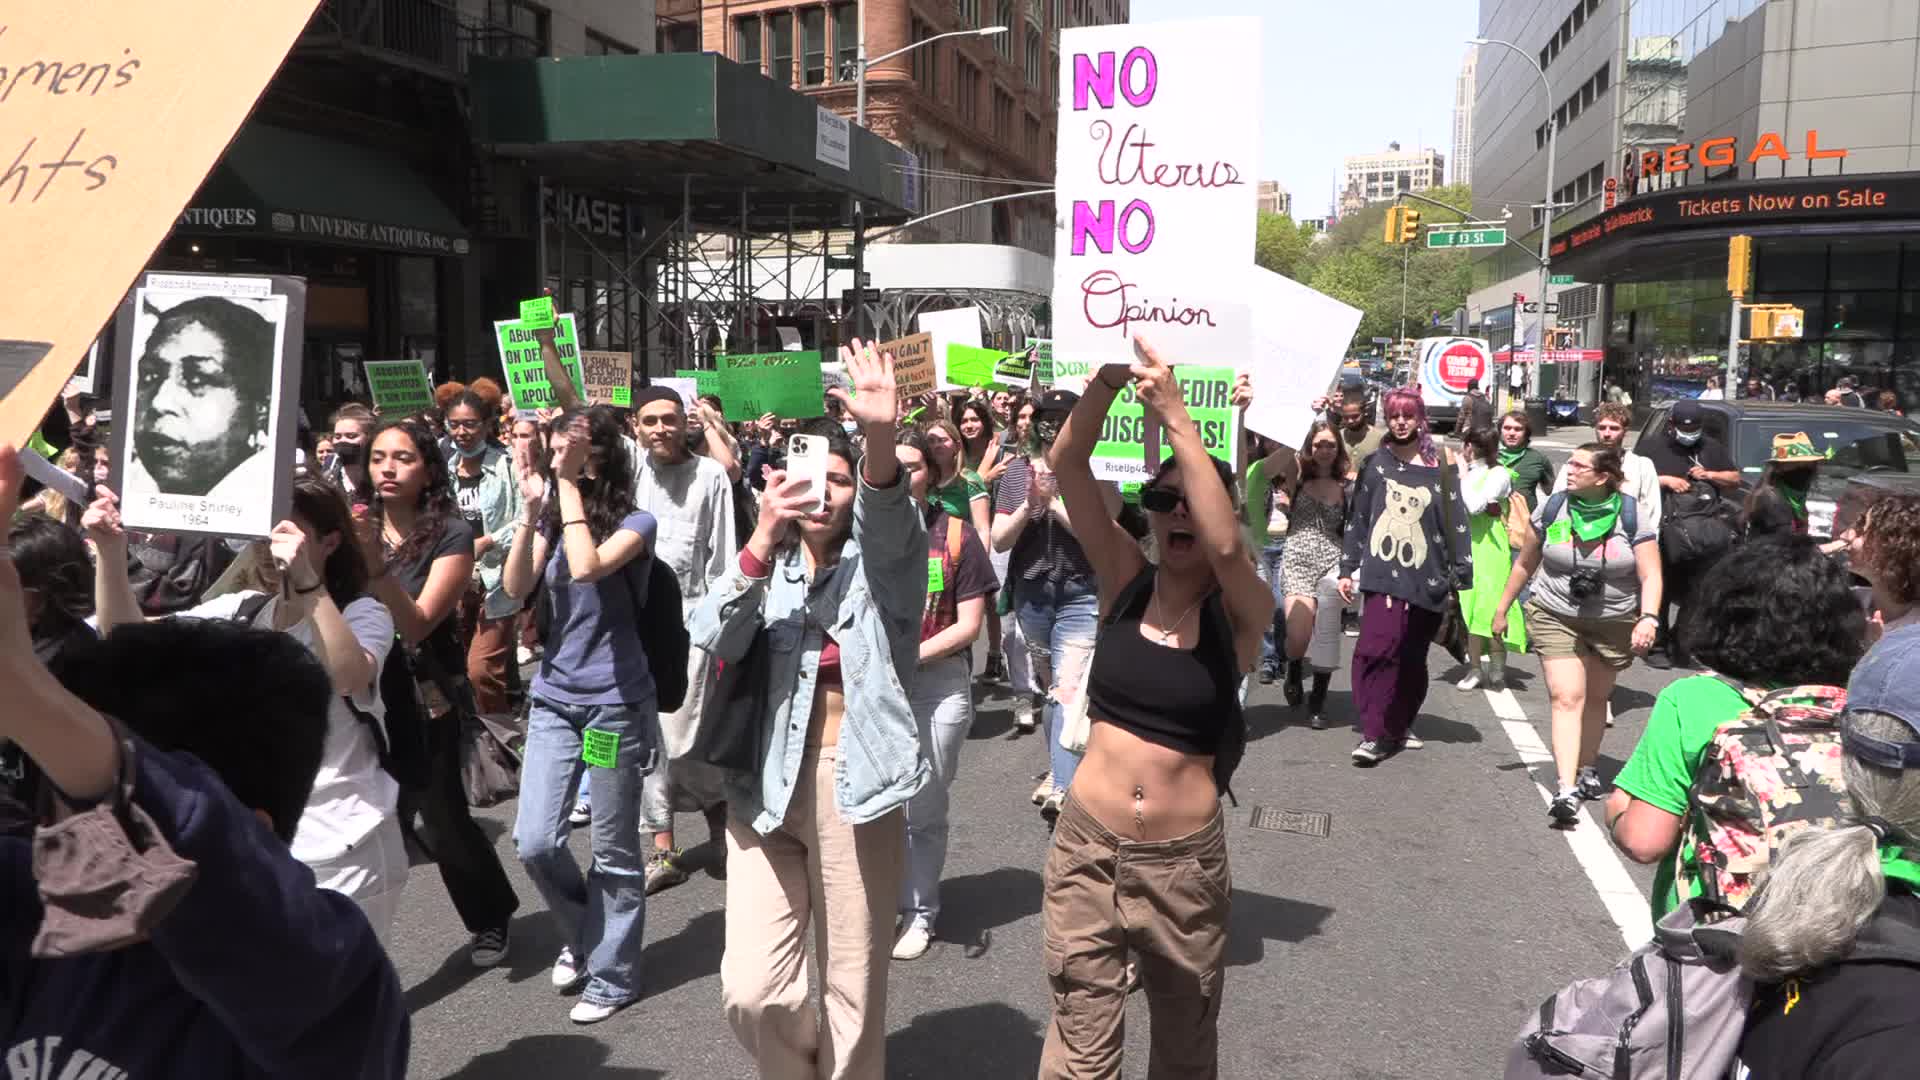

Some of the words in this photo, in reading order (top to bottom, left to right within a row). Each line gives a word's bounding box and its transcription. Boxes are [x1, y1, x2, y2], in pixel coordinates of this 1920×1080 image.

[1073, 46, 1158, 111] NO
[1089, 119, 1245, 188] Uterus
[1639, 130, 1848, 178] REGAL
[1071, 198, 1155, 256] NO
[1679, 199, 1741, 217] Tickets
[1748, 194, 1795, 211] Now
[1801, 194, 1829, 209] on
[1836, 189, 1887, 207] Sale
[300, 213, 369, 240] UNIVERSE
[370, 224, 432, 248] ANTIQUES
[1459, 233, 1470, 243] 13
[1081, 270, 1217, 338] Opinion
[1180, 379, 1228, 409] EDIR
